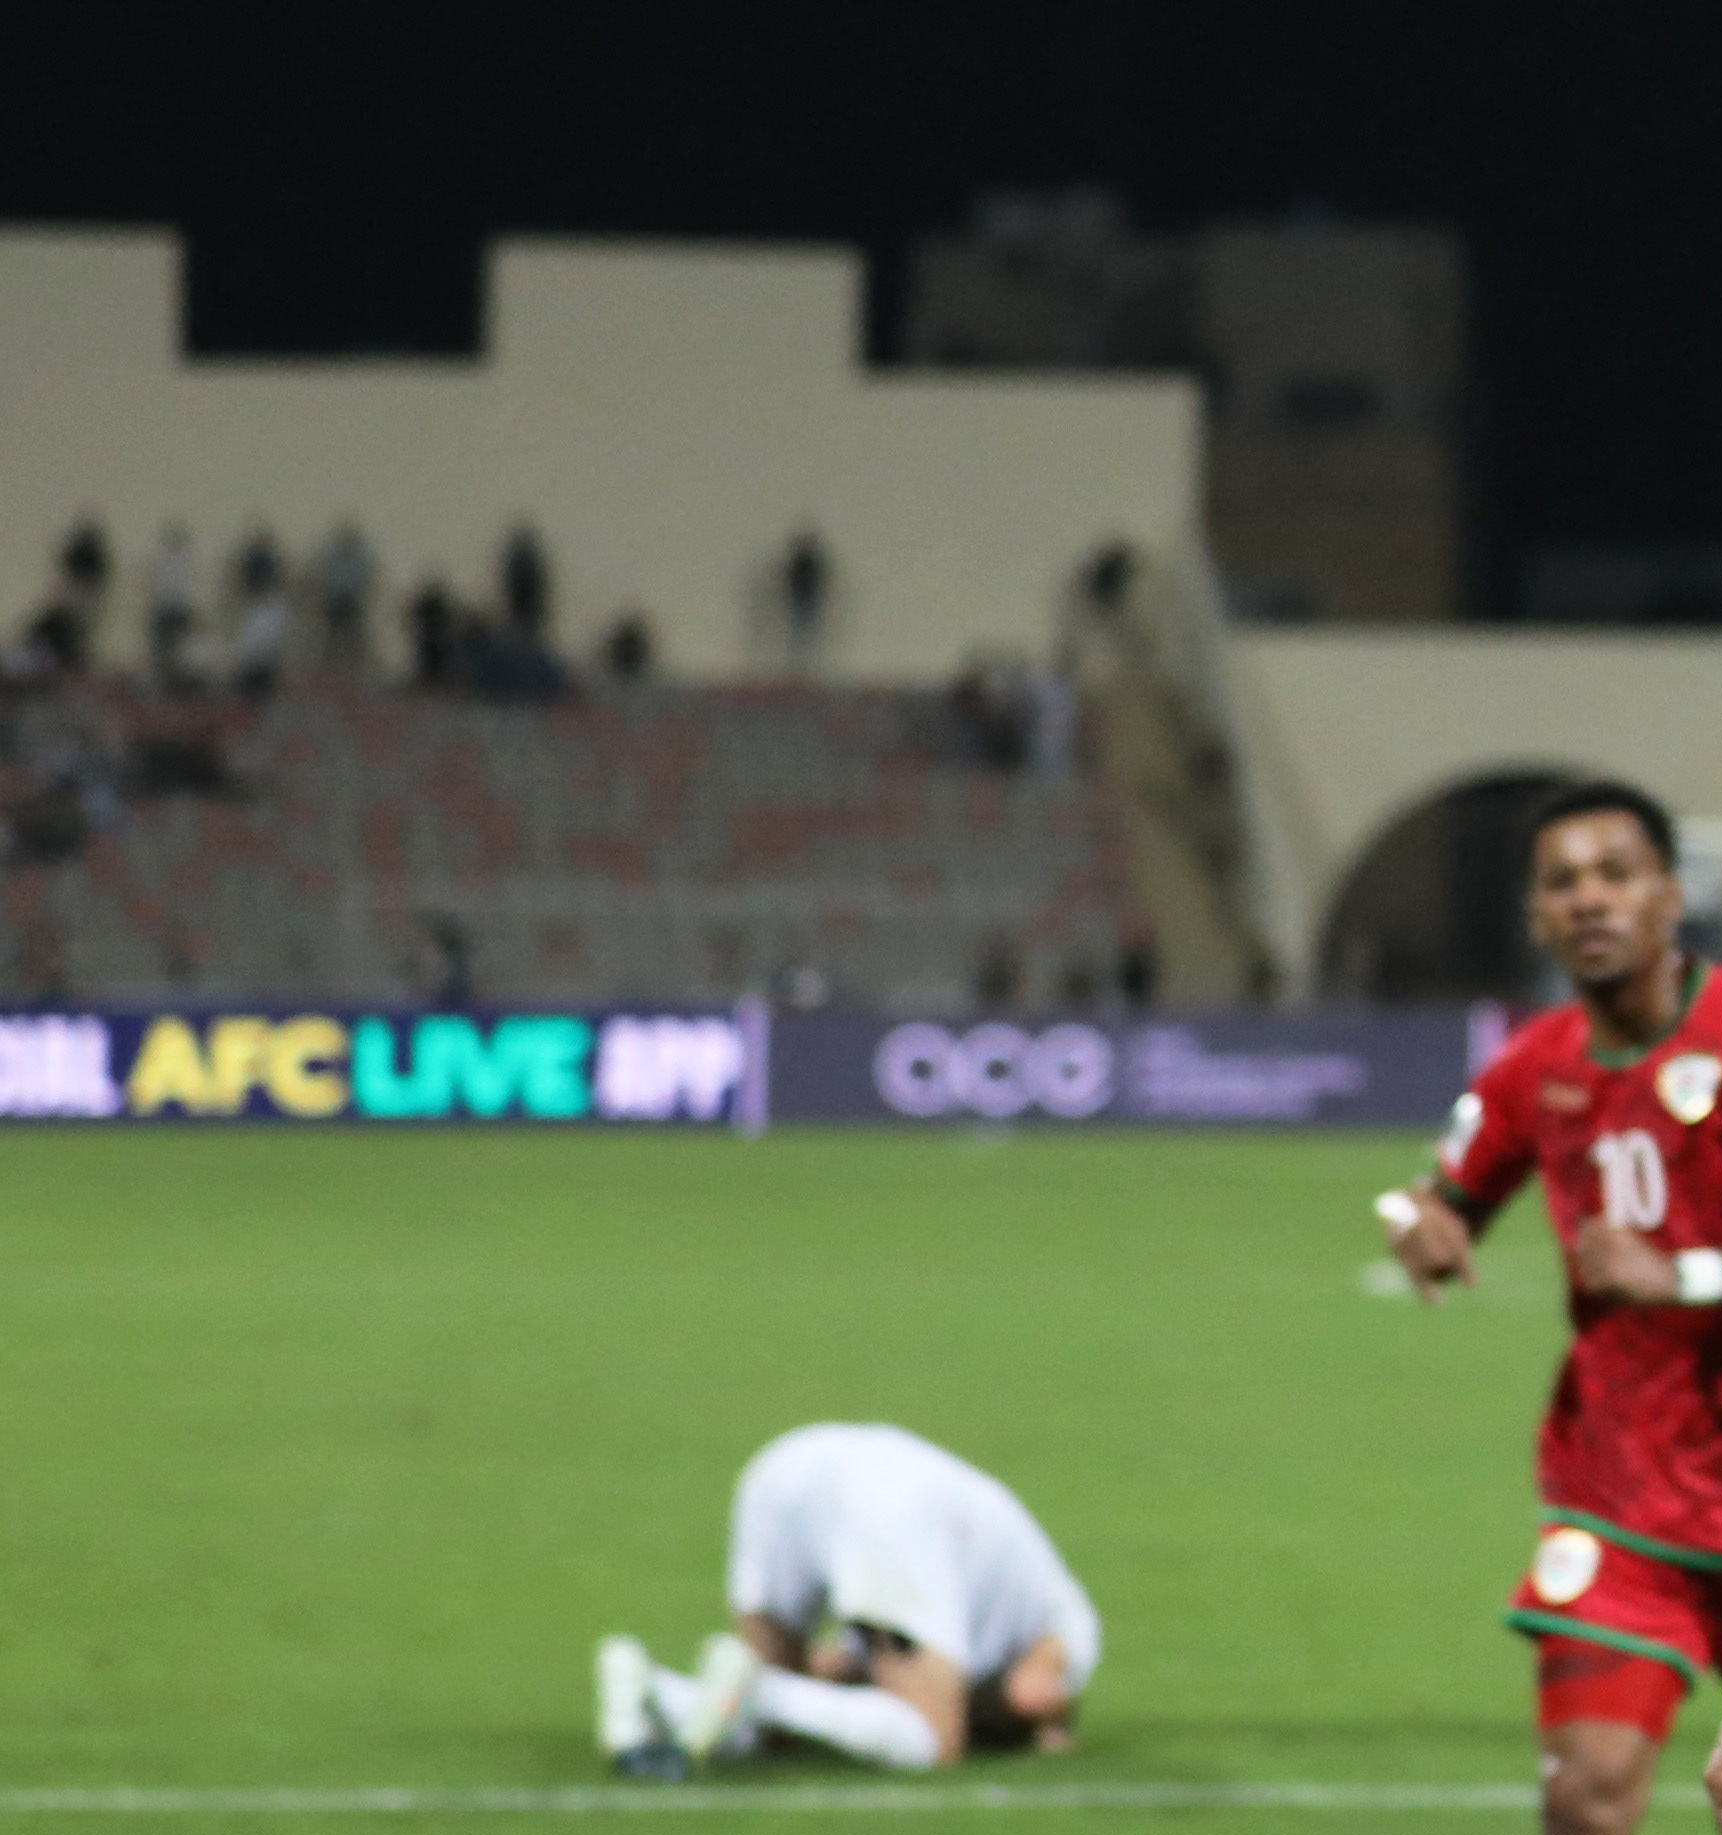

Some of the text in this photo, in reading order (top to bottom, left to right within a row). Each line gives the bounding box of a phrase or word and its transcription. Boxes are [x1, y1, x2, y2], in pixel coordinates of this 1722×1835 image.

[126, 1014, 349, 1119] AFC
[350, 1014, 594, 1120] LIVE
[1590, 1128, 1668, 1231] 10
